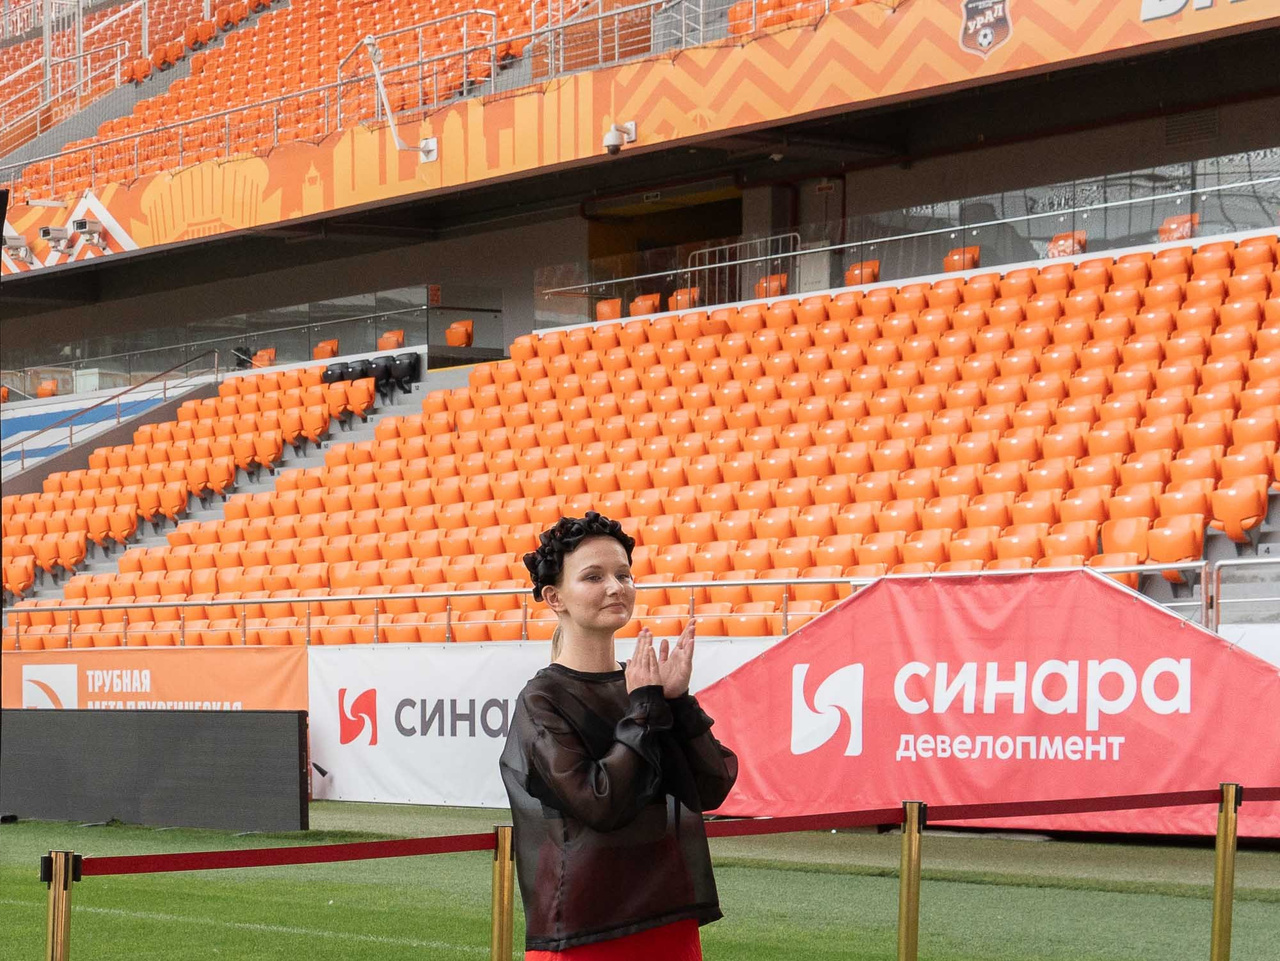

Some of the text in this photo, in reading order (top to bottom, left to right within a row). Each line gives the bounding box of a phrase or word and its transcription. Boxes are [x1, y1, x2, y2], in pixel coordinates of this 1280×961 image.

[967, 4, 1003, 34] УРАЛ
[86, 668, 151, 694] ТРУБНАЯ
[394, 697, 517, 740] сина
[896, 733, 1125, 762] девелопмент
